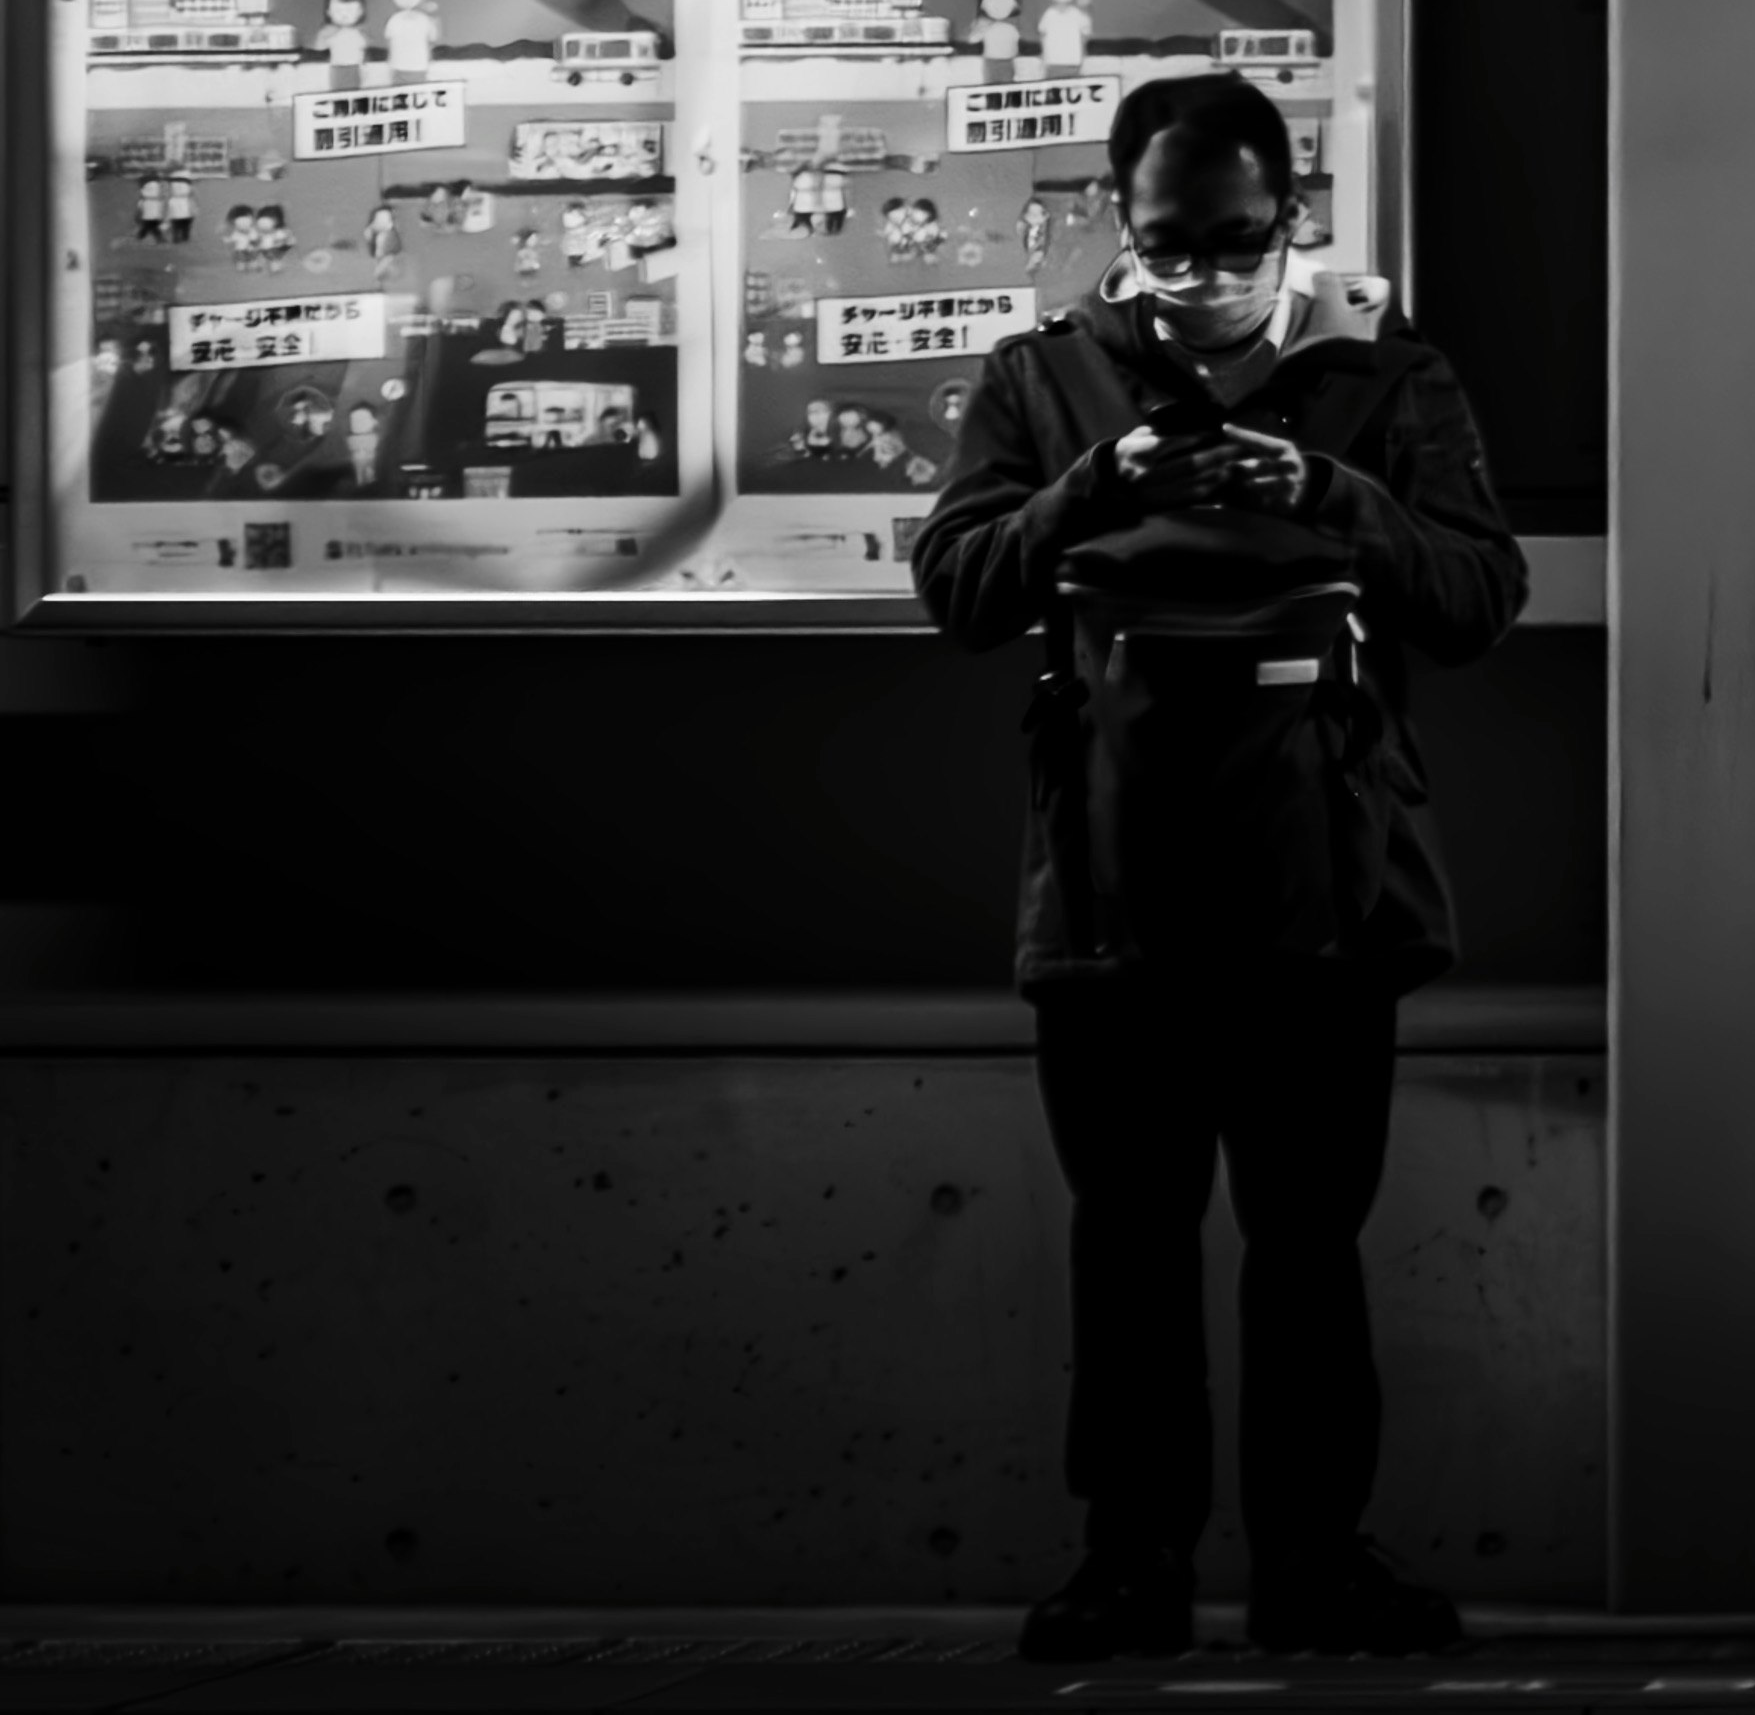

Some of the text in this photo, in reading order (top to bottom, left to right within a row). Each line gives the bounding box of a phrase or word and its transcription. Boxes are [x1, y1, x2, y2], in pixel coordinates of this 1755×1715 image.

[841, 295, 1013, 325] チャージ不だから
